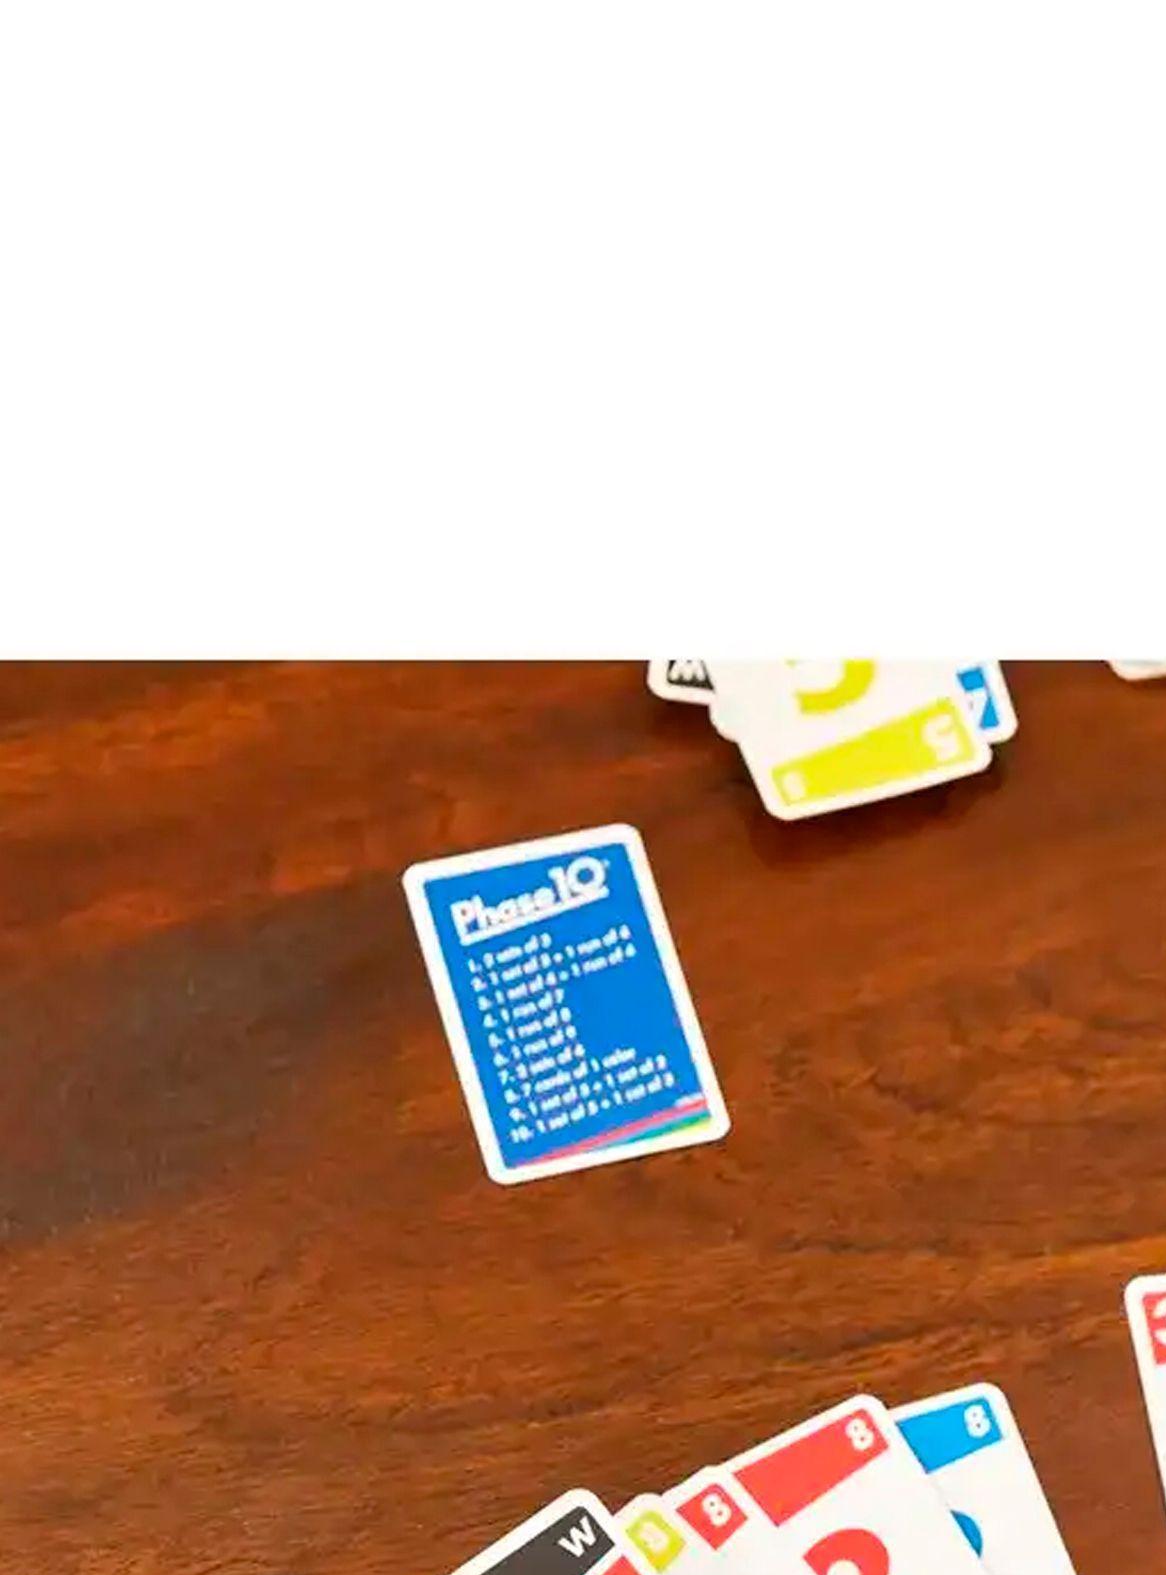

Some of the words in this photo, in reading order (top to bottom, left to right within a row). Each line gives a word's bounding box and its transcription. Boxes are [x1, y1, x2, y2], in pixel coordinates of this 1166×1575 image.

[845, 1418, 873, 1451] 8
[963, 1404, 990, 1437] 8
[701, 1493, 732, 1527] 8
[557, 1515, 597, 1557] W
